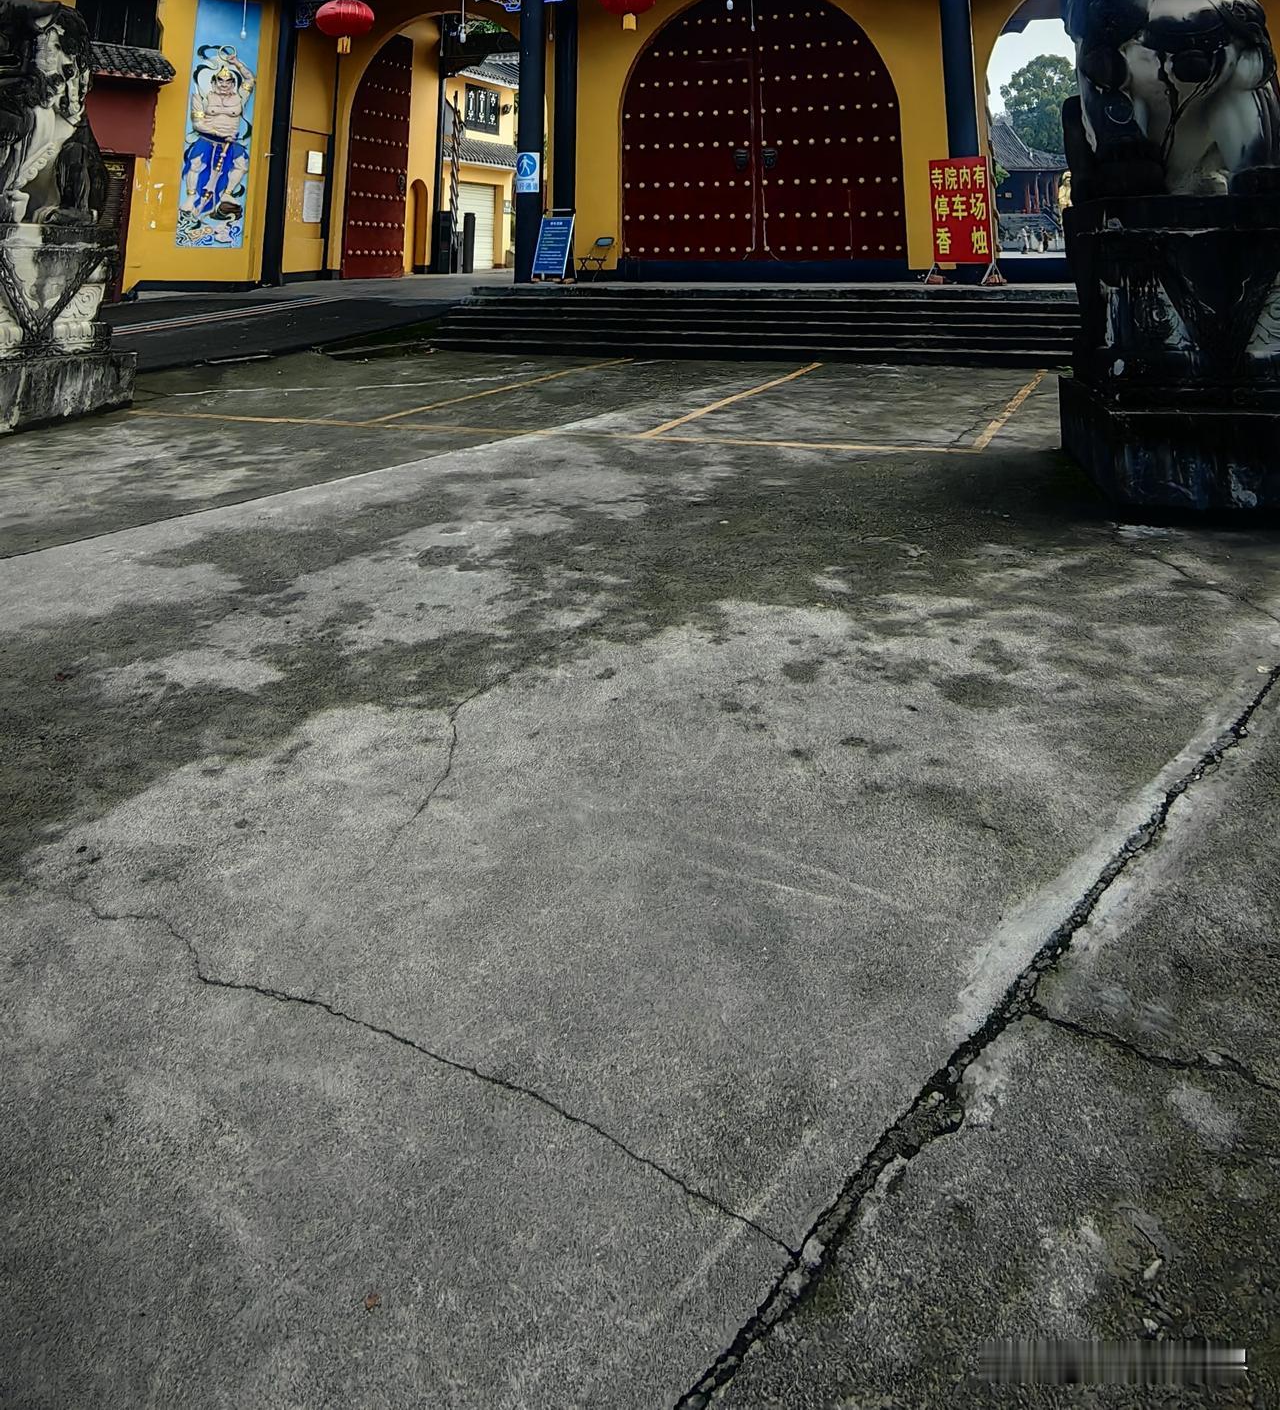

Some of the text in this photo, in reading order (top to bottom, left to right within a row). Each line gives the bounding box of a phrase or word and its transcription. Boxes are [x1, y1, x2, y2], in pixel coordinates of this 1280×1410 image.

[931, 165, 986, 190] 寺院内有
[935, 193, 987, 222] 停车场
